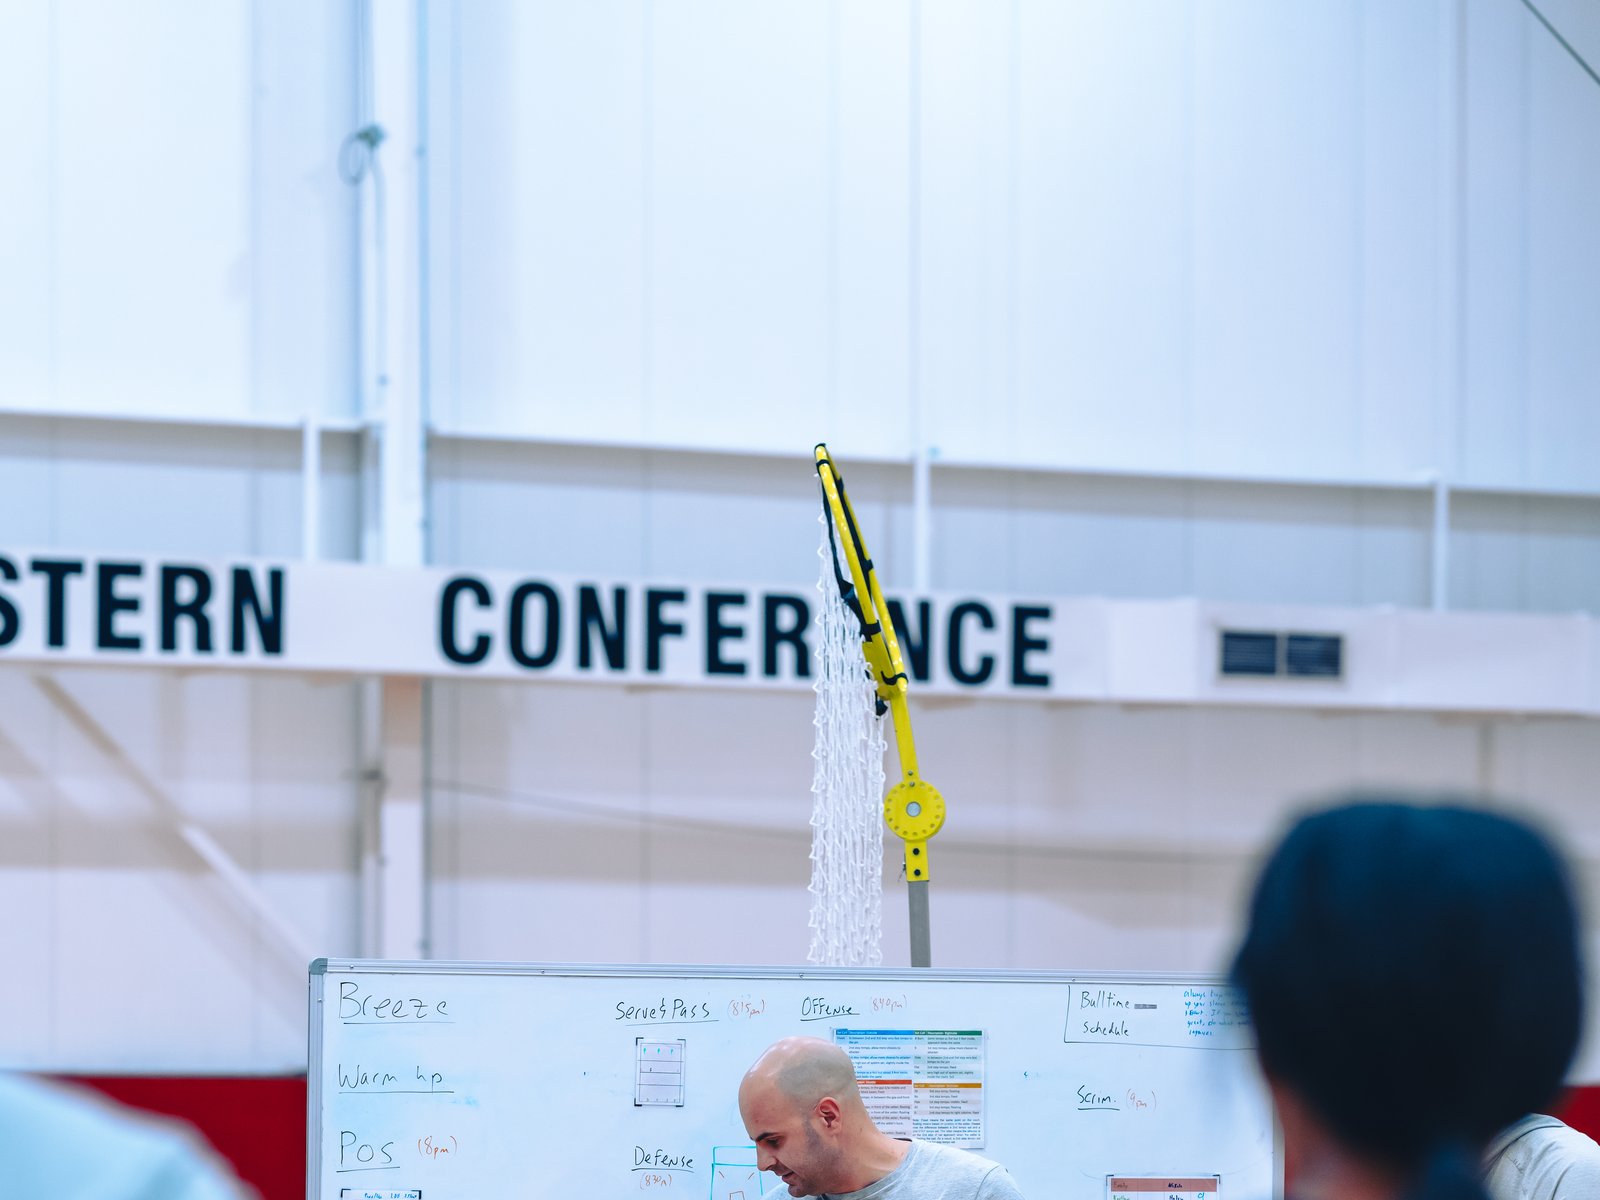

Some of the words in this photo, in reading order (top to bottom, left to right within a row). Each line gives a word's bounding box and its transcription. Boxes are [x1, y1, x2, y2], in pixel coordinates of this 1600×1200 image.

[439, 576, 1053, 687] CONFERNCE
[339, 981, 449, 1019] Breeze
[1083, 1020, 1130, 1038] Schedule
[338, 1063, 398, 1089] Warm
[340, 1130, 395, 1168] Pos
